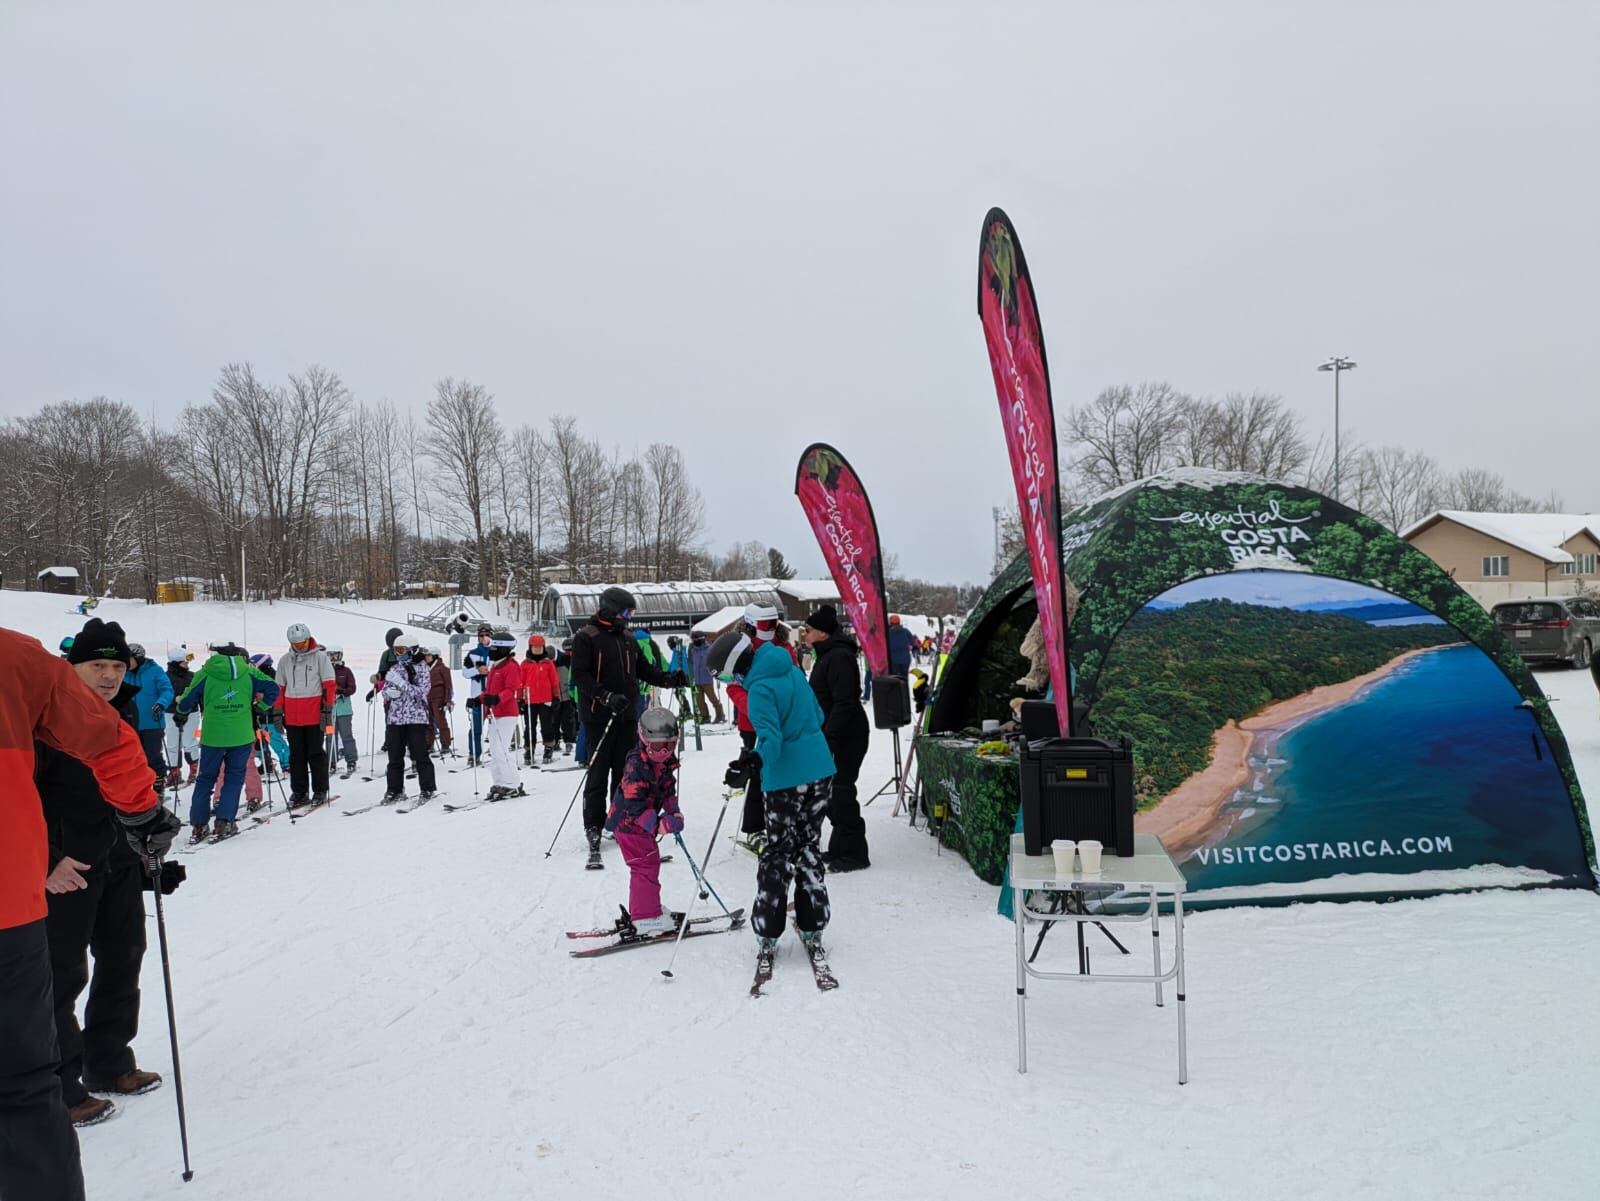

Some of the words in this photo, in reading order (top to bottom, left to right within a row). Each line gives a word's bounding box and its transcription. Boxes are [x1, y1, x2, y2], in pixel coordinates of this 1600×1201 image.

[817, 477, 863, 574] essential
[1150, 499, 1312, 531] essential
[1221, 516, 1312, 545] COSTA
[825, 523, 854, 577] COSTA
[848, 574, 868, 615] RICA
[1228, 545, 1297, 563] RICA
[1196, 836, 1453, 865] VISITCOSTARICA.COM
